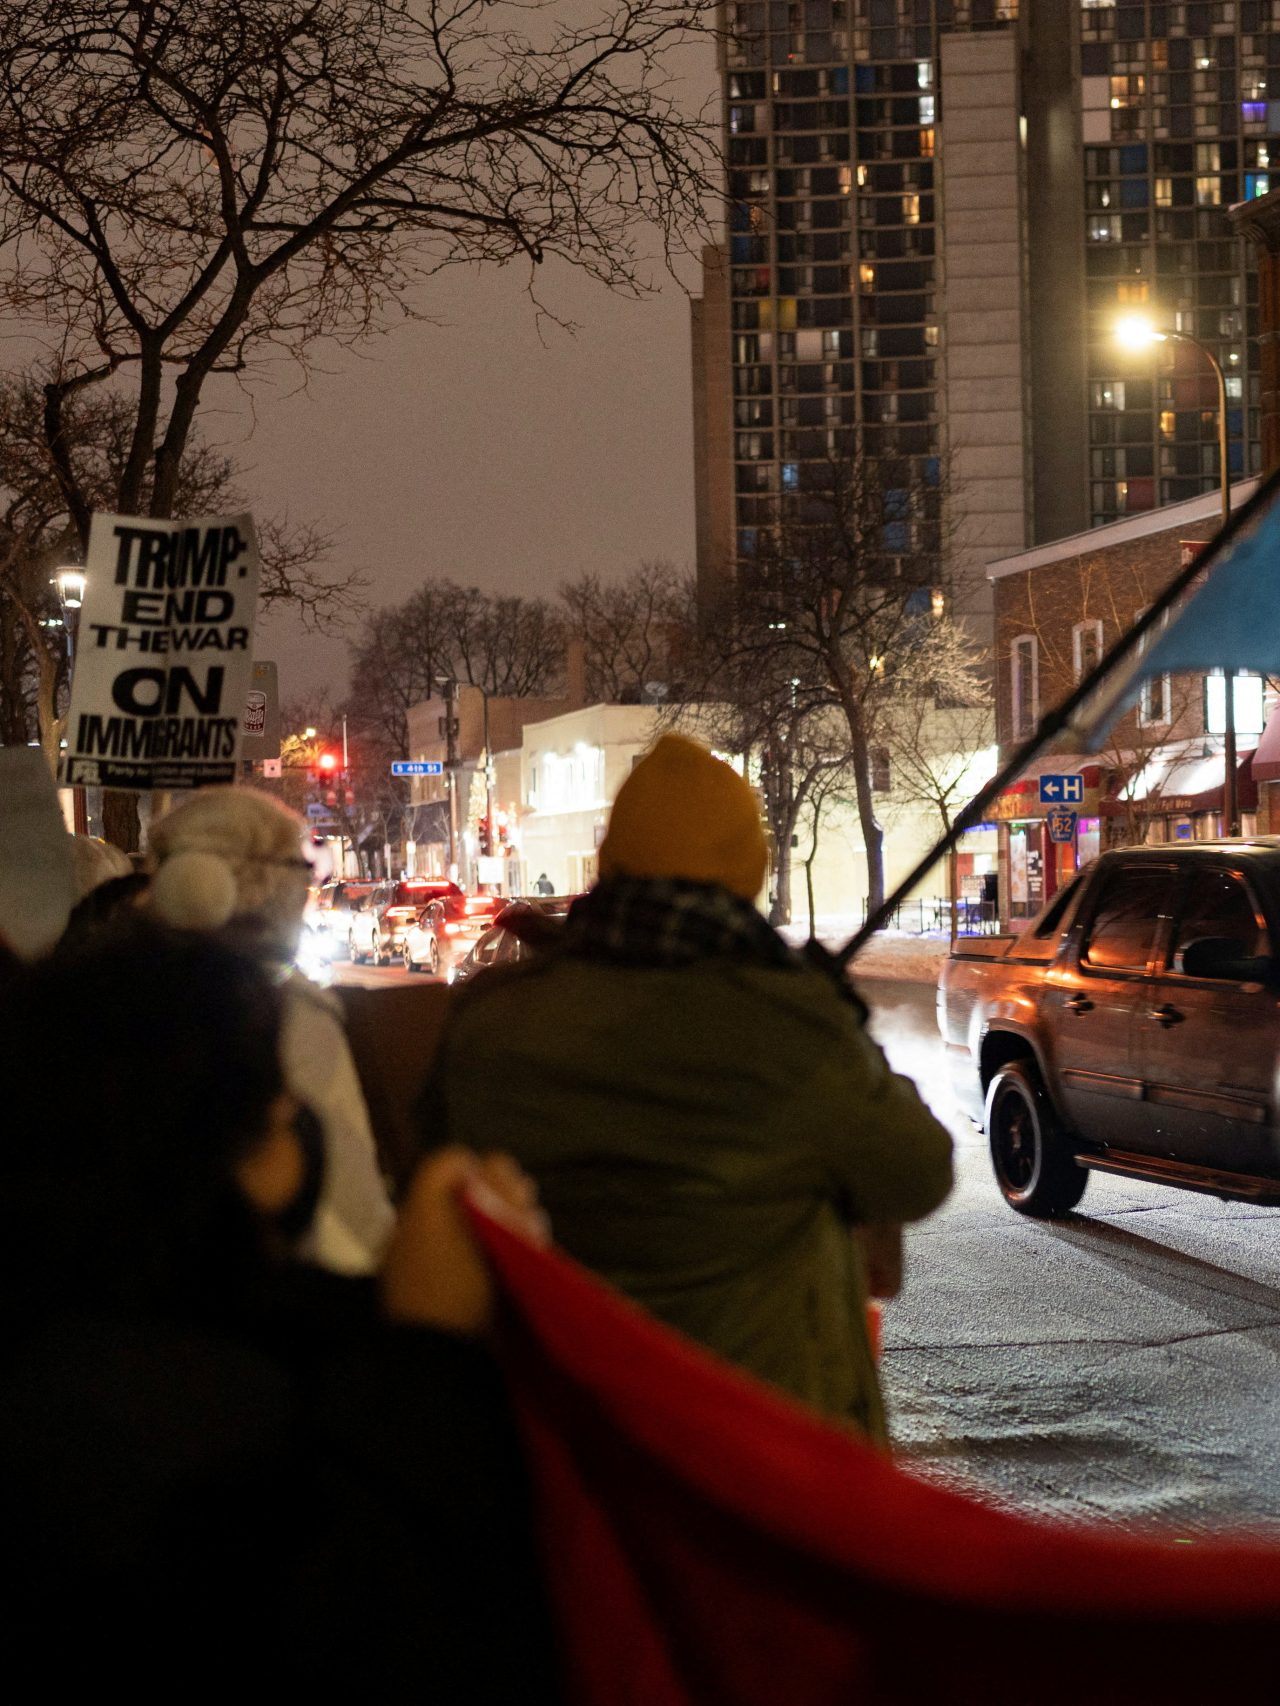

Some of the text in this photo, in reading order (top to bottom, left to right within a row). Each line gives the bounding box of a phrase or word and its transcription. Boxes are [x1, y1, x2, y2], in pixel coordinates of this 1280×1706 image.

[122, 590, 235, 625] END
[90, 624, 248, 653] THE WAR
[112, 666, 225, 717] ON
[77, 714, 238, 759] IMMIGRANTS
[1063, 779, 1080, 799] H
